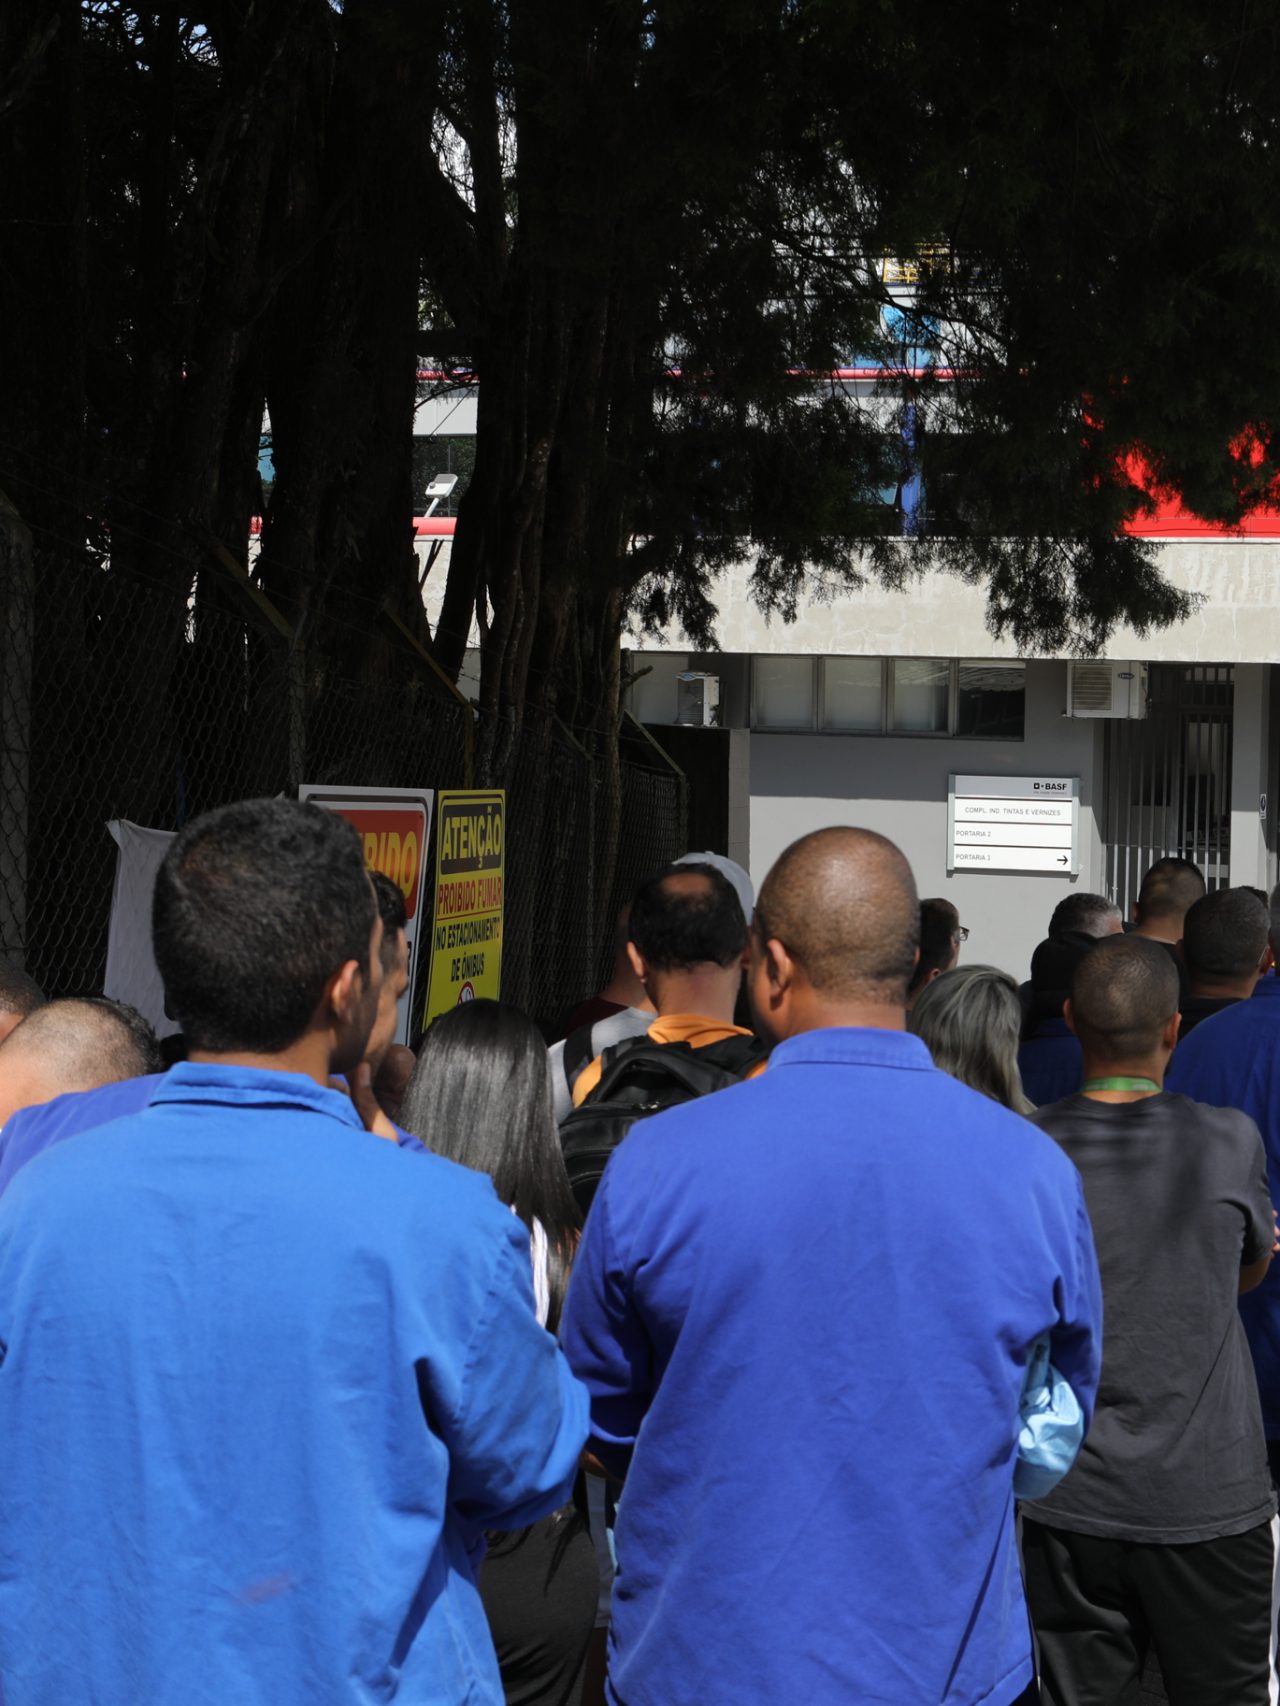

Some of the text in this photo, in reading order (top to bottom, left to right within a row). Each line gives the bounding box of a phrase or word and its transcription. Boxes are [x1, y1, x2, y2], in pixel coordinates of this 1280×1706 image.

[1045, 782, 1067, 790] BASF
[1003, 807, 1024, 815] TINTAS
[1031, 808, 1061, 816] VERNIZES
[441, 805, 501, 868] ATENÇÃO
[437, 876, 502, 914] PROIBIDO FUMAR
[435, 926, 446, 951] NO
[451, 951, 485, 982] DE ÔNIBUS
